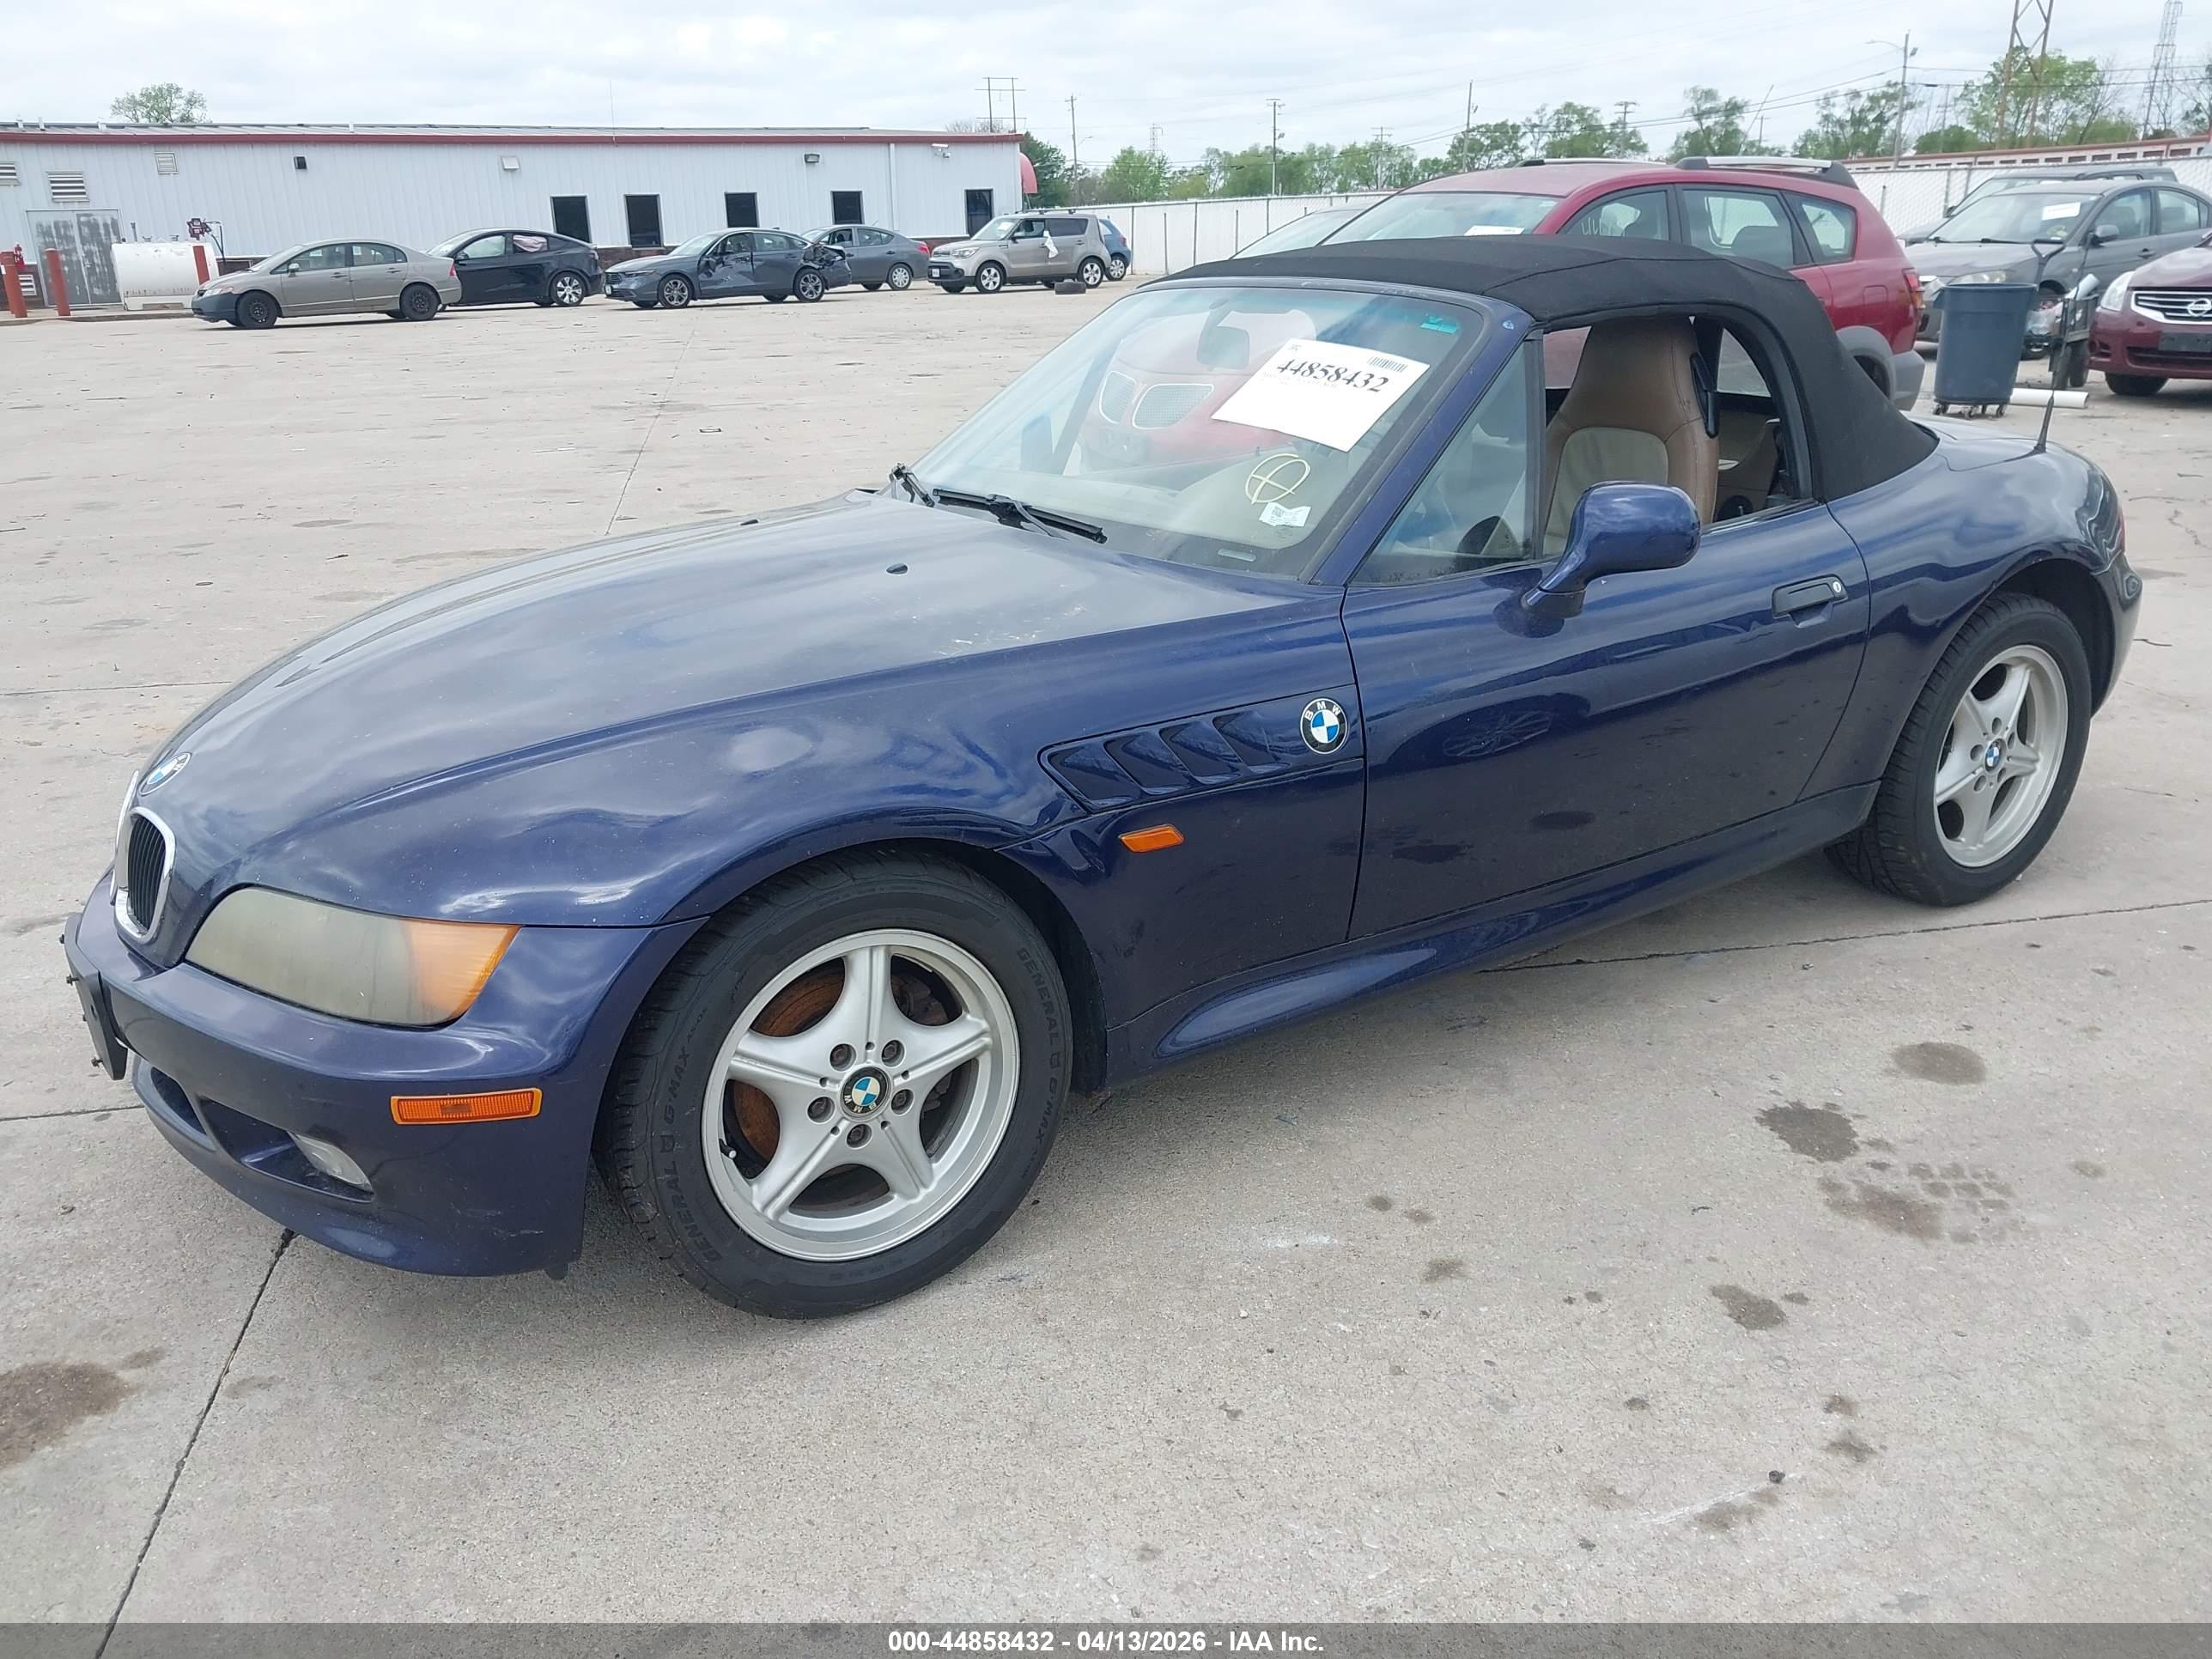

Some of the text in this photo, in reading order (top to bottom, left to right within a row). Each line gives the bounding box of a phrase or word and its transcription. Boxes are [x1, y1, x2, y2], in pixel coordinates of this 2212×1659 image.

[1277, 359, 1389, 392] 44858432
[1304, 701, 1341, 720] BMW
[1017, 947, 1059, 1046] GENERAL
[844, 1094, 877, 1113] BMW
[666, 1160, 722, 1261] GENERAL
